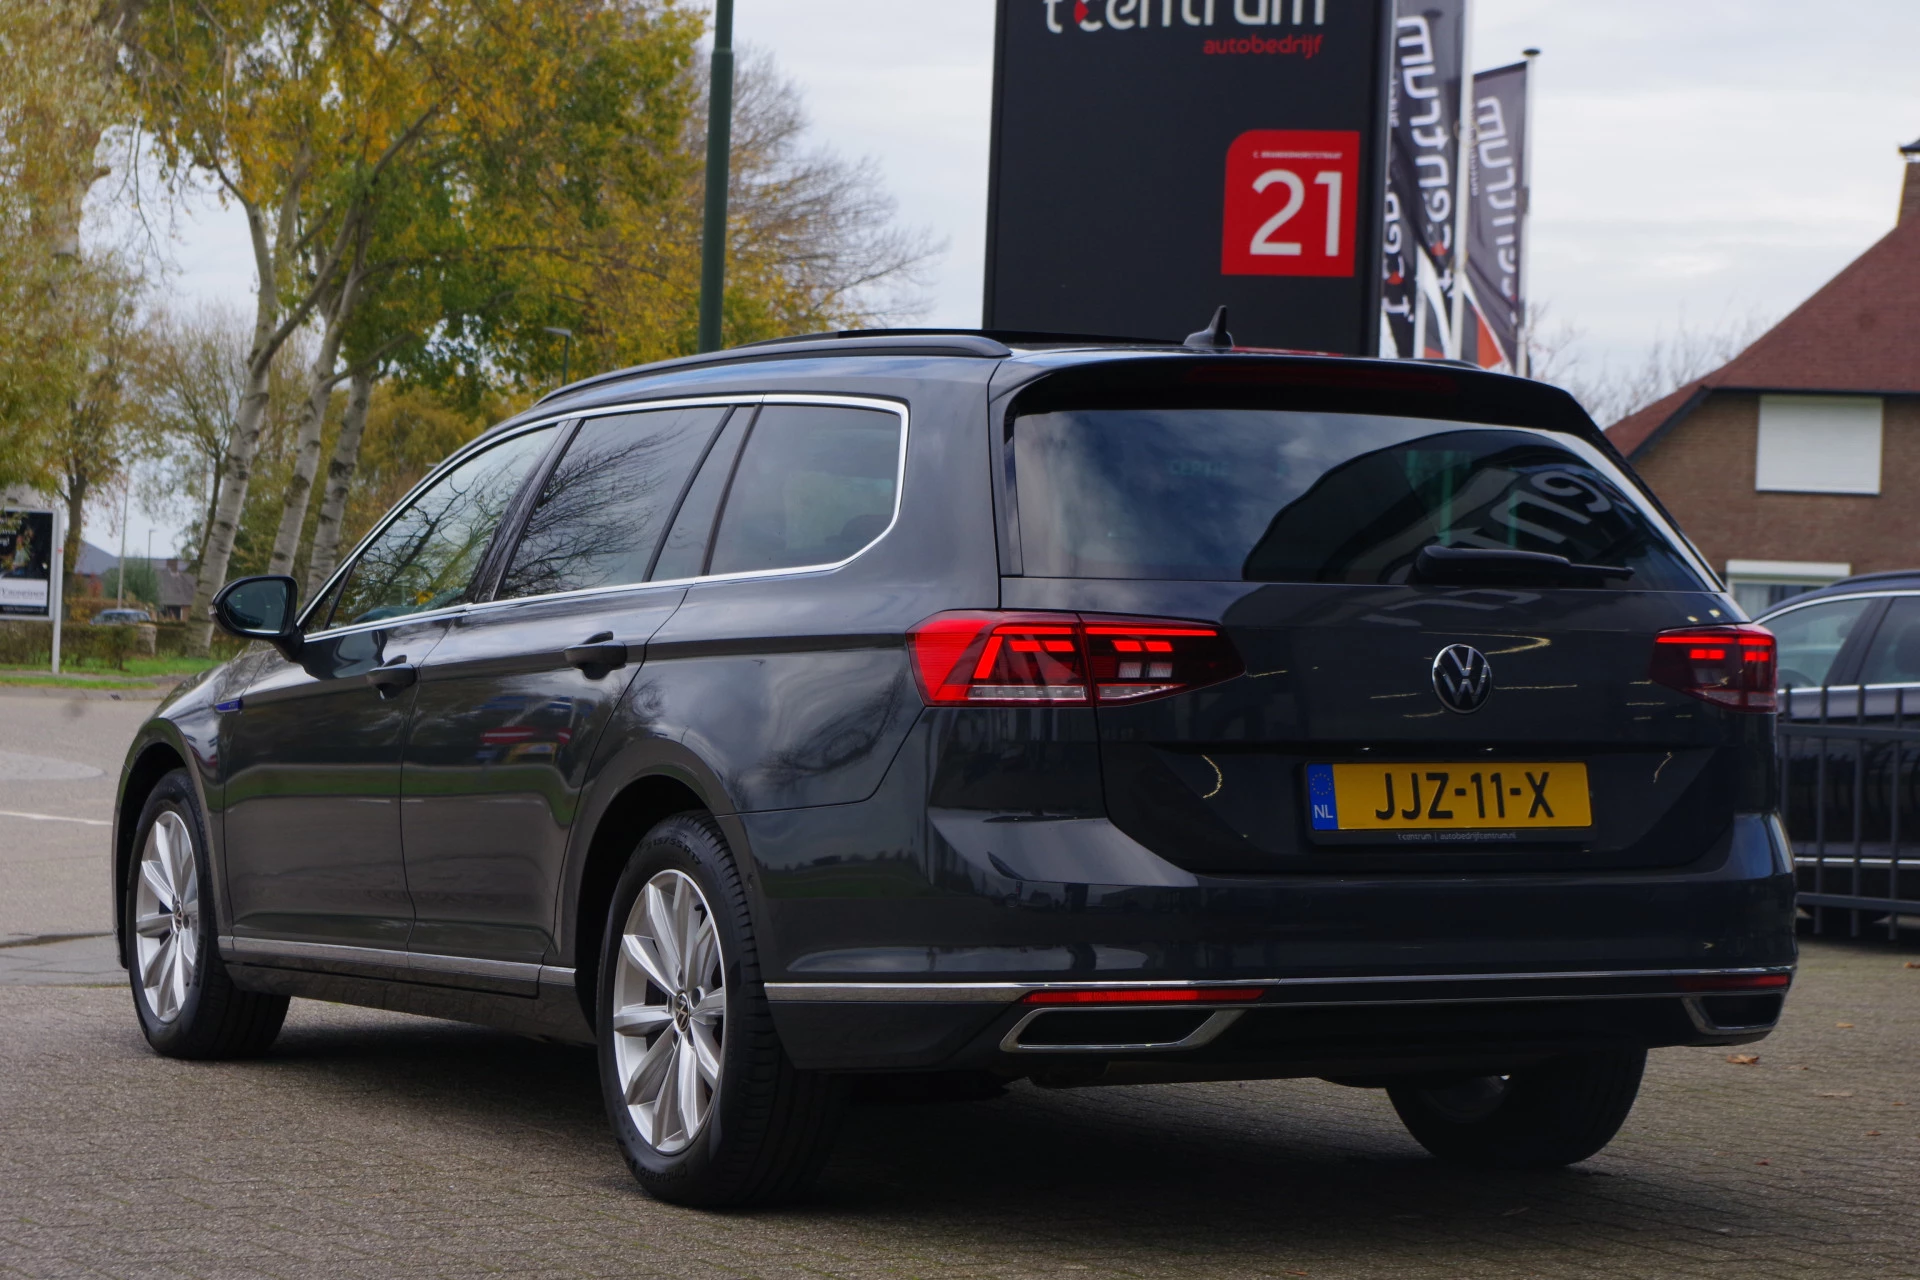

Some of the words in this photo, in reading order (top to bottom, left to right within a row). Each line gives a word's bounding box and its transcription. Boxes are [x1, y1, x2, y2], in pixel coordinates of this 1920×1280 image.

[1203, 34, 1324, 59] autobedrijf
[1249, 169, 1342, 256] 21
[1314, 804, 1334, 819] NL
[1375, 771, 1555, 820] JJZ-11-X
